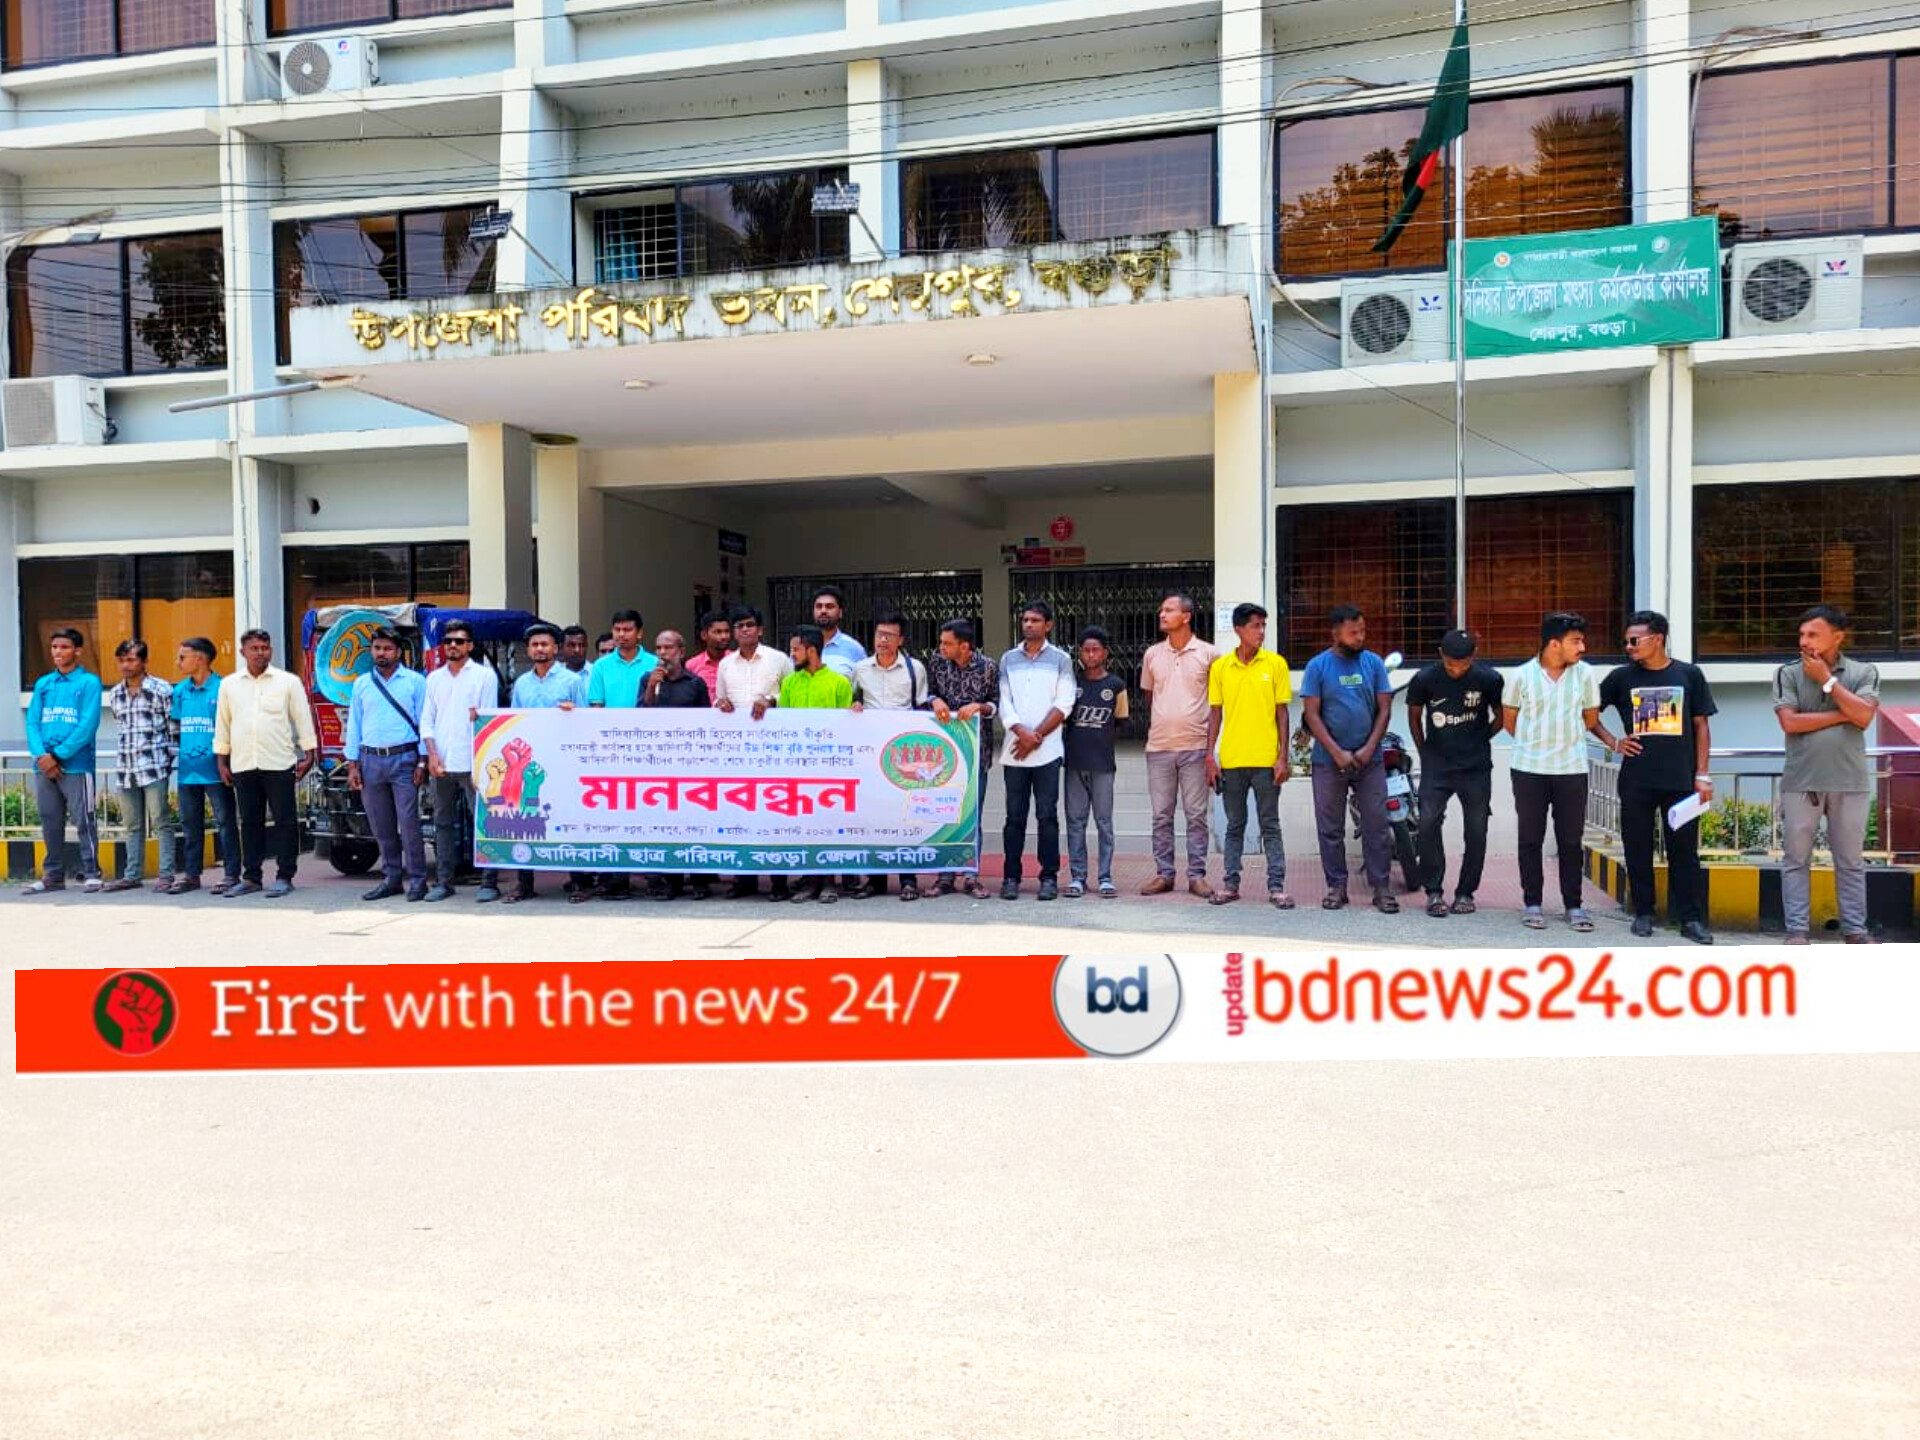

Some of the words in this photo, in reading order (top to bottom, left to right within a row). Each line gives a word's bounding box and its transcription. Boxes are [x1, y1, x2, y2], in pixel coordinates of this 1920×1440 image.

[1504, 276, 1557, 314] উপজেলা
[1659, 257, 1712, 298] কার্যালয়
[348, 304, 525, 350] উপজেলা
[541, 288, 690, 340] পরিষদ
[579, 775, 860, 817] মানববন্ধন
[534, 843, 622, 863] আদিবাসী
[628, 846, 667, 864] ছাত্র
[673, 845, 743, 866] পরিষদ,
[750, 848, 809, 867] বগুড়া
[815, 849, 871, 865] জেলা
[875, 845, 940, 865] কমিটি
